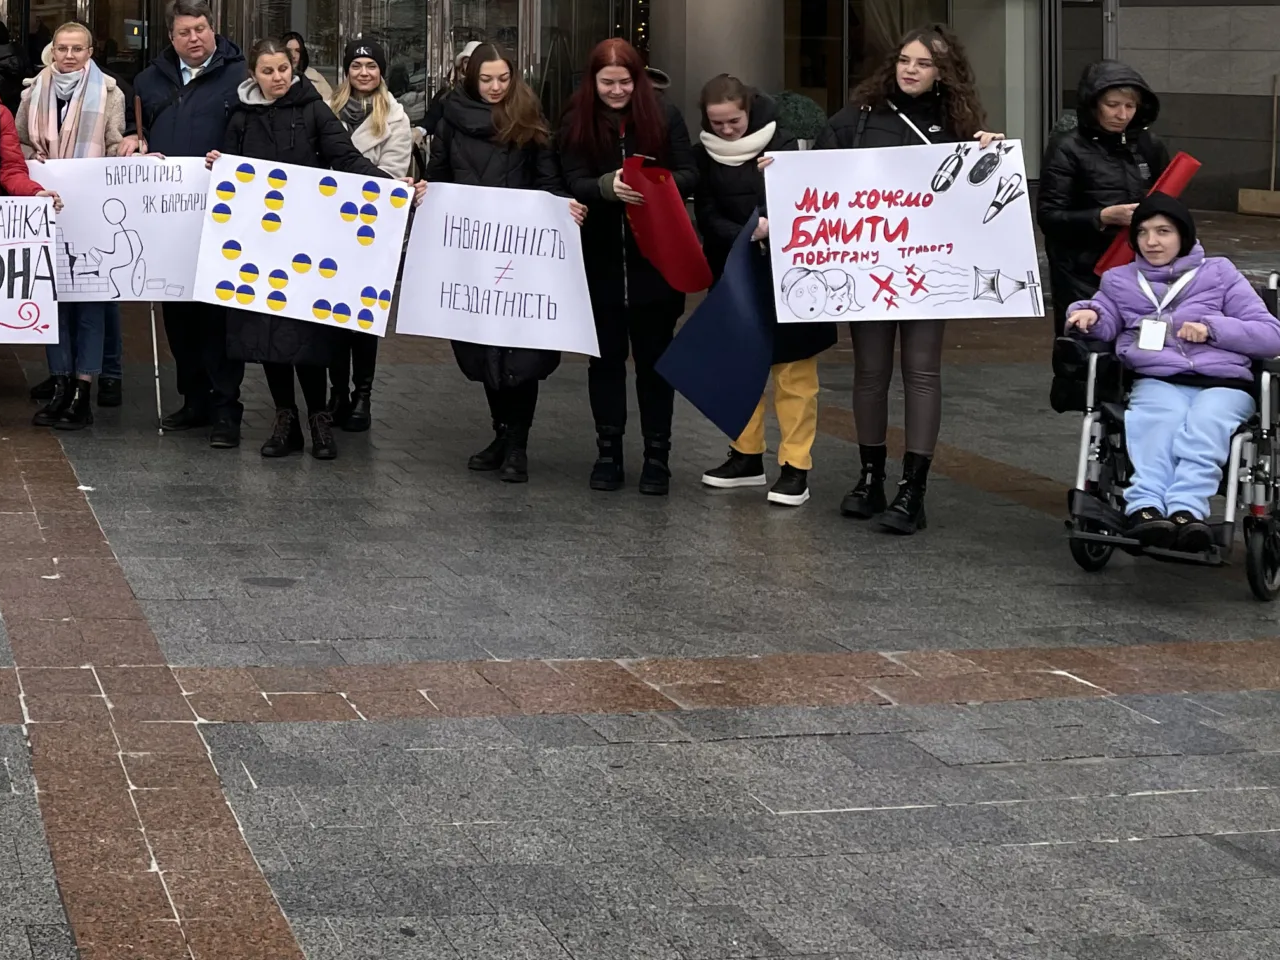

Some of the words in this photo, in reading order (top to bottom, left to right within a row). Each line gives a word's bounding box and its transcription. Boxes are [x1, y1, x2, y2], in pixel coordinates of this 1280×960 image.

[105, 164, 149, 186] БАРЕРИ
[153, 164, 184, 184] ГРИЗ,
[142, 194, 158, 214] ЯК
[847, 188, 934, 210] хочемо
[443, 212, 566, 260] ІНВАЛІДНІСТЬ
[781, 215, 910, 253] БАЧИТИ
[439, 281, 558, 321] НЕЗДАТНІСТЬ
